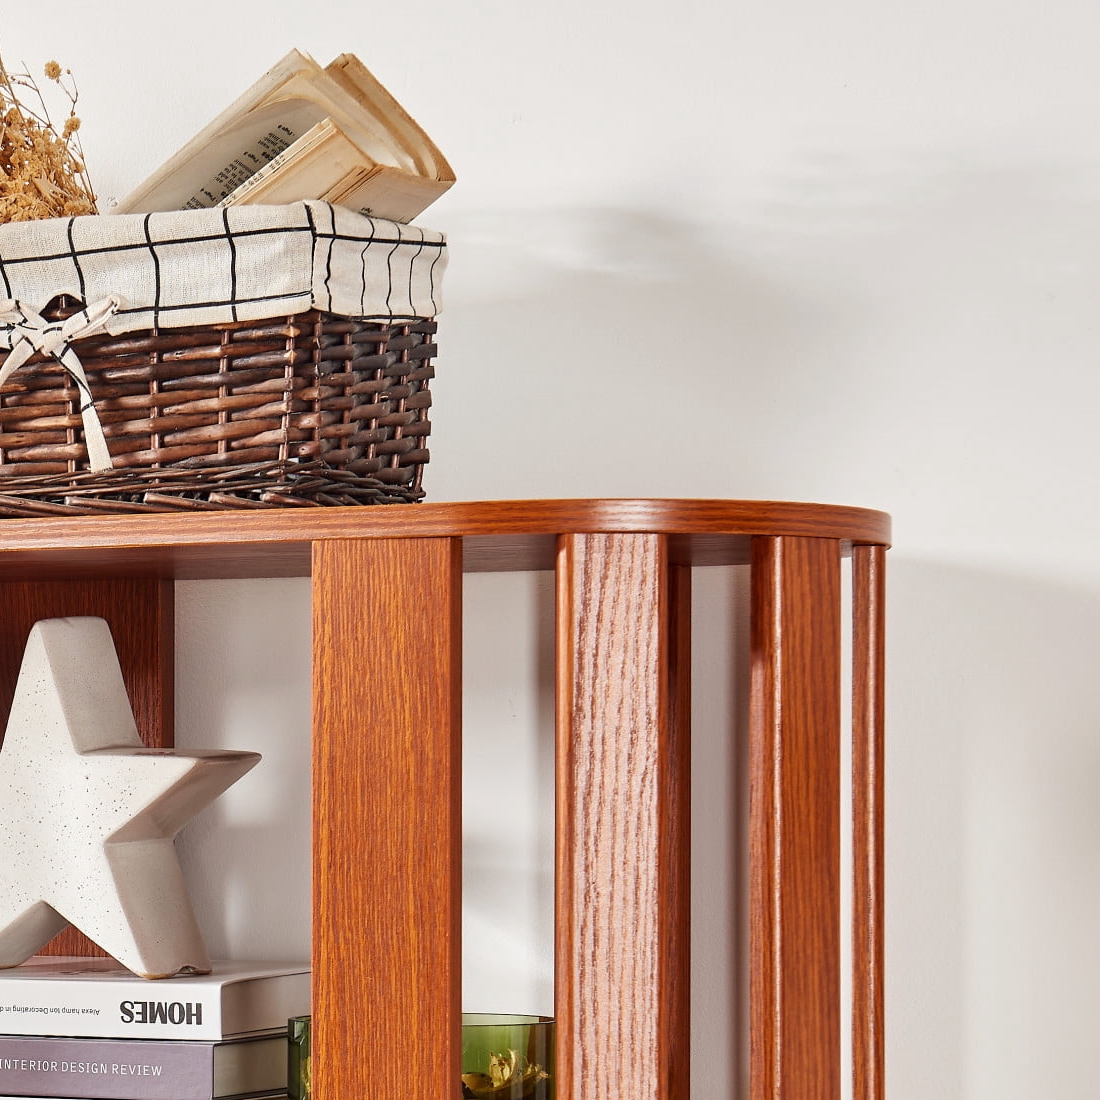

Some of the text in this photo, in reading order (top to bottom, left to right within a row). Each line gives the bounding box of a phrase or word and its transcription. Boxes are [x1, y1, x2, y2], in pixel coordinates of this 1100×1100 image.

[13, 1004, 49, 1014] Decorating
[120, 1000, 202, 1025] HOMES
[61, 1060, 108, 1074] DESIGN
[111, 1062, 163, 1077] REVIEW
